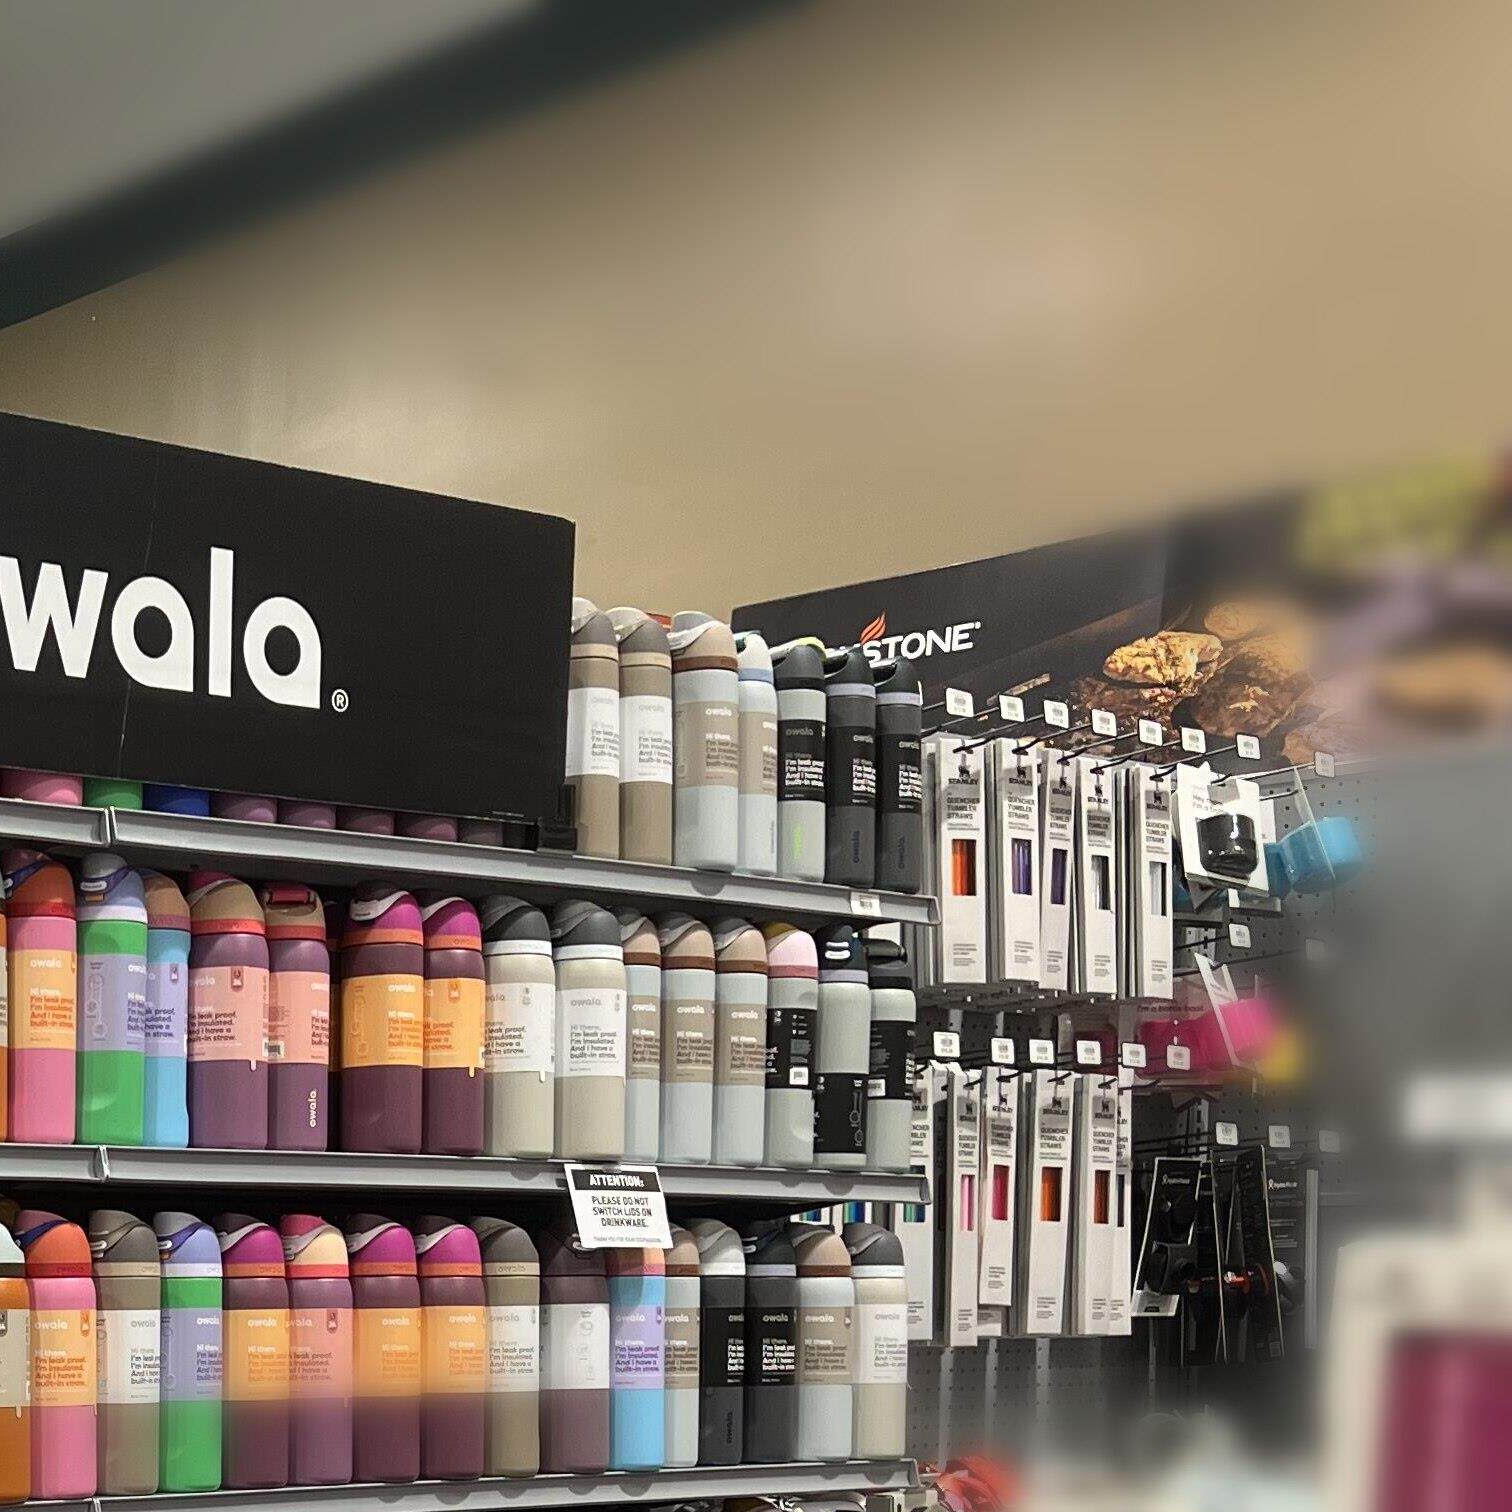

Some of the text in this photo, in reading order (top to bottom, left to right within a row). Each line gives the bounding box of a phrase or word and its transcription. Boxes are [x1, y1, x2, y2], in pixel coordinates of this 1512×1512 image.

[786, 728, 813, 736] owala
[308, 1090, 317, 1127] owala
[590, 1174, 644, 1187] ATTENTION:
[592, 1196, 648, 1205] PLEASE DO NOT
[593, 1207, 652, 1216] SWITCH LIDS ON
[616, 1313, 646, 1322] owala
[762, 1313, 788, 1322] owala
[805, 1314, 834, 1323] owala
